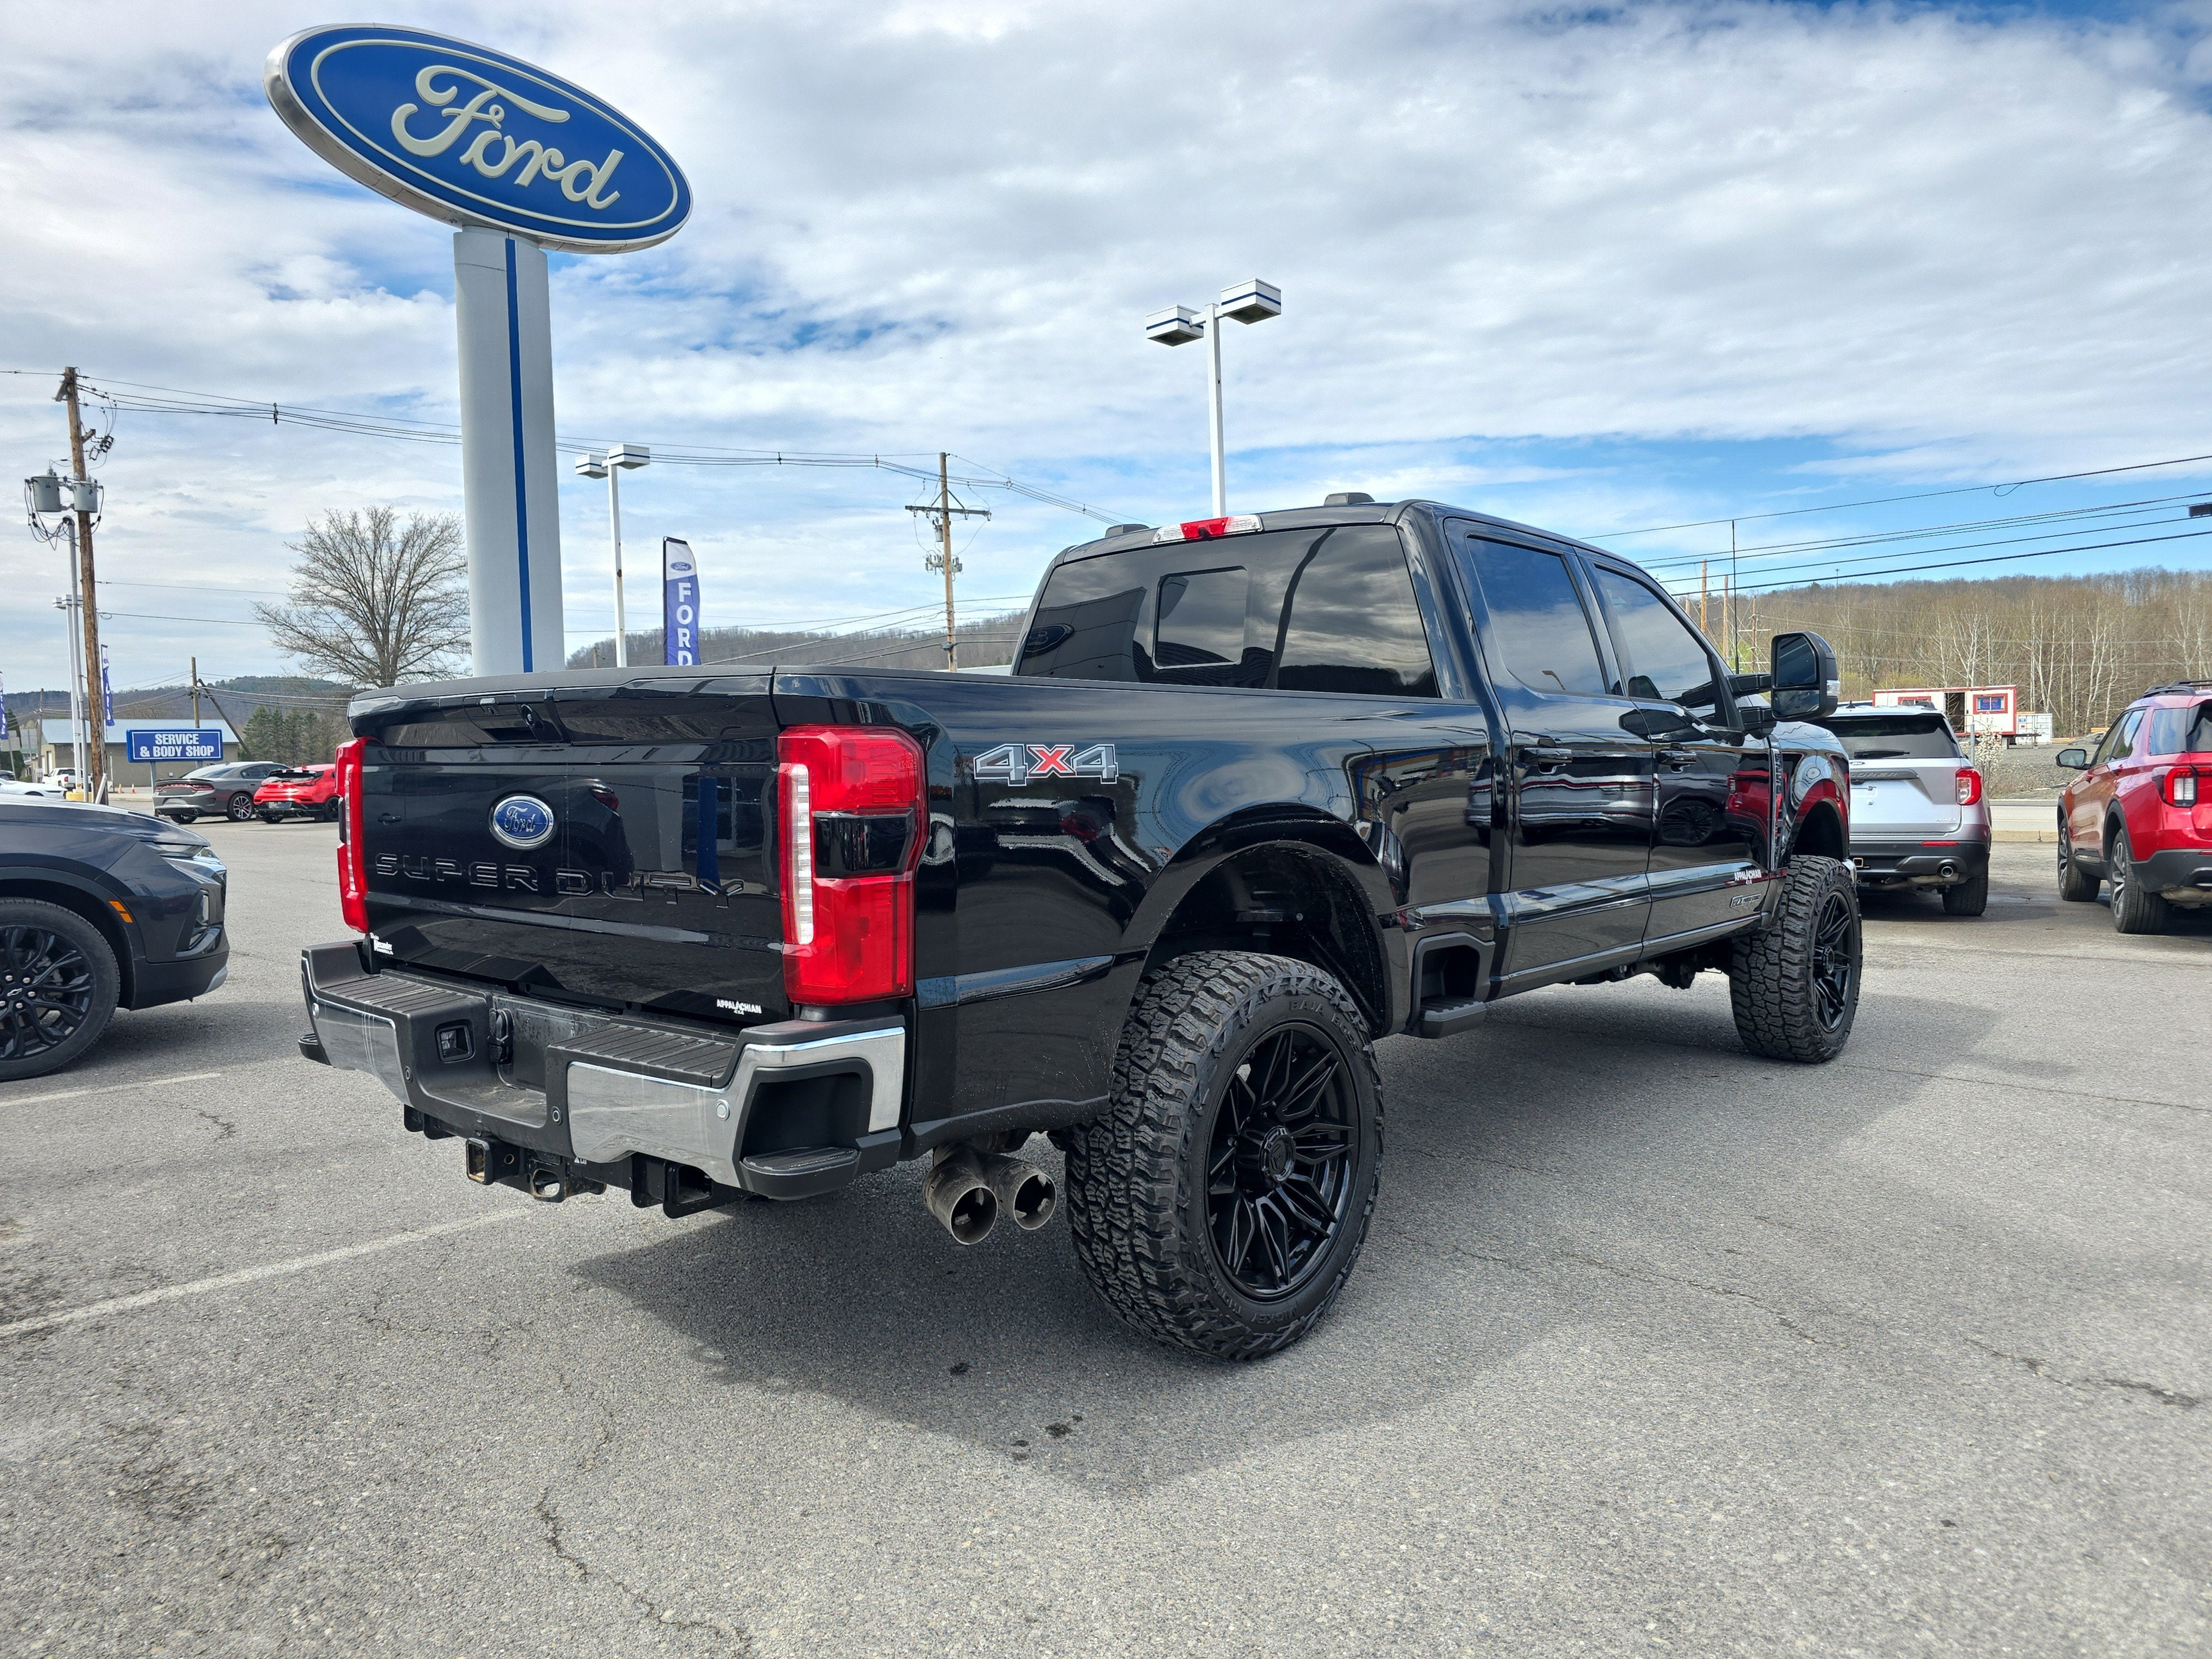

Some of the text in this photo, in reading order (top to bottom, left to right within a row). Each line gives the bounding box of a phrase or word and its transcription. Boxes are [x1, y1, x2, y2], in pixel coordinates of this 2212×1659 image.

[391, 65, 623, 210] Ford
[676, 582, 693, 666] FORD
[155, 734, 200, 745] SERVICE
[140, 745, 214, 757] & BODY SHOP
[504, 806, 536, 833] Ford
[375, 852, 744, 909] SUPER DUTY
[1734, 869, 1762, 882] APPALACHIAN
[716, 998, 762, 1014] APPALACHIAN
[1289, 1000, 1324, 1016] BAJA
